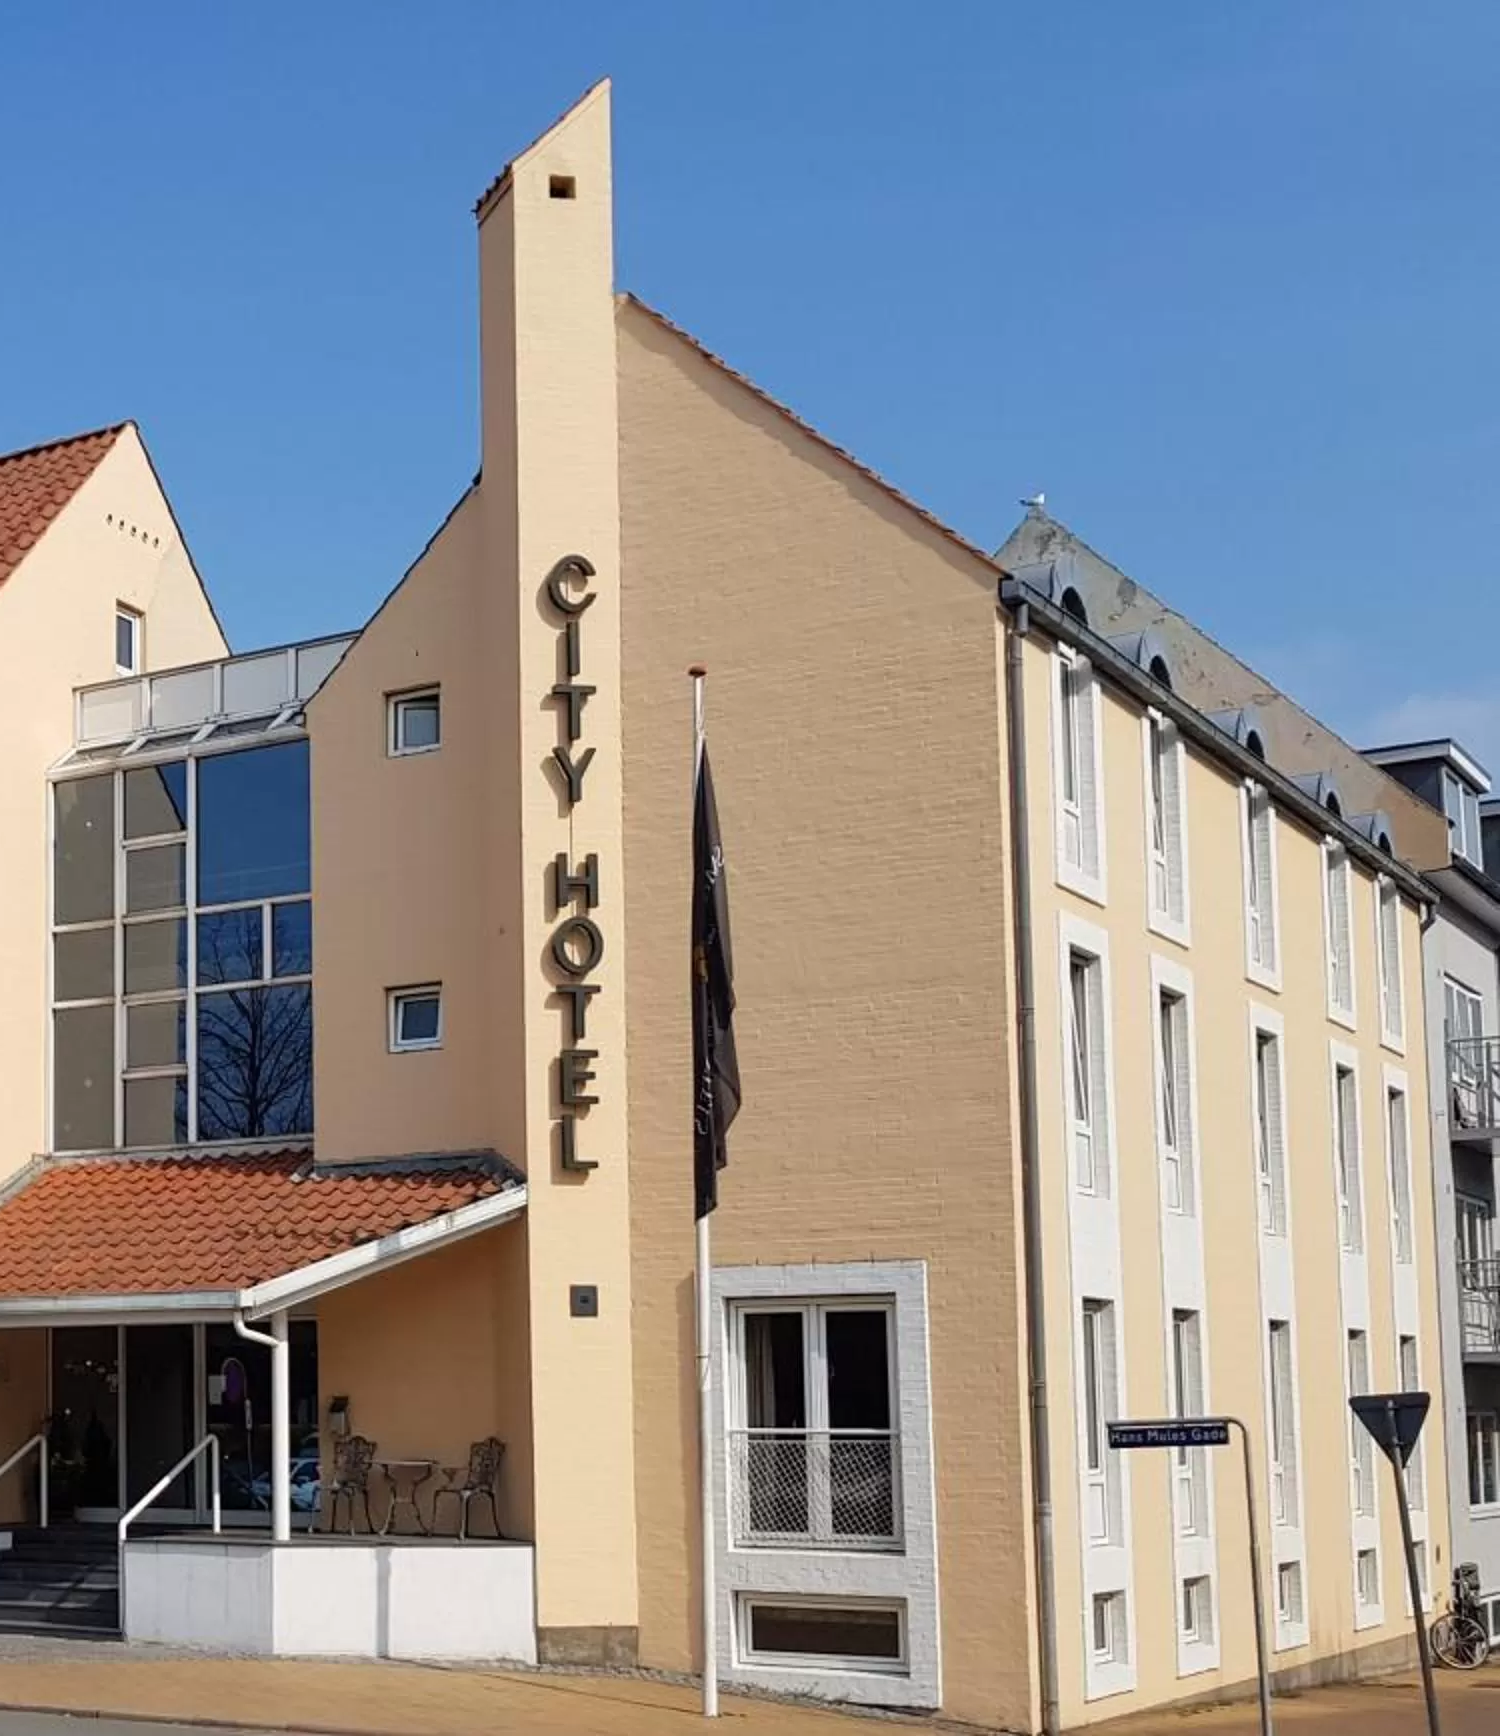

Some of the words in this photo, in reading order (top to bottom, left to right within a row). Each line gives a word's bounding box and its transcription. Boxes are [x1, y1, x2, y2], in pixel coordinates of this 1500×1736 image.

[548, 554, 597, 802] CITY
[552, 852, 604, 1170] HOTEL
[1147, 1429, 1187, 1441] Mules
